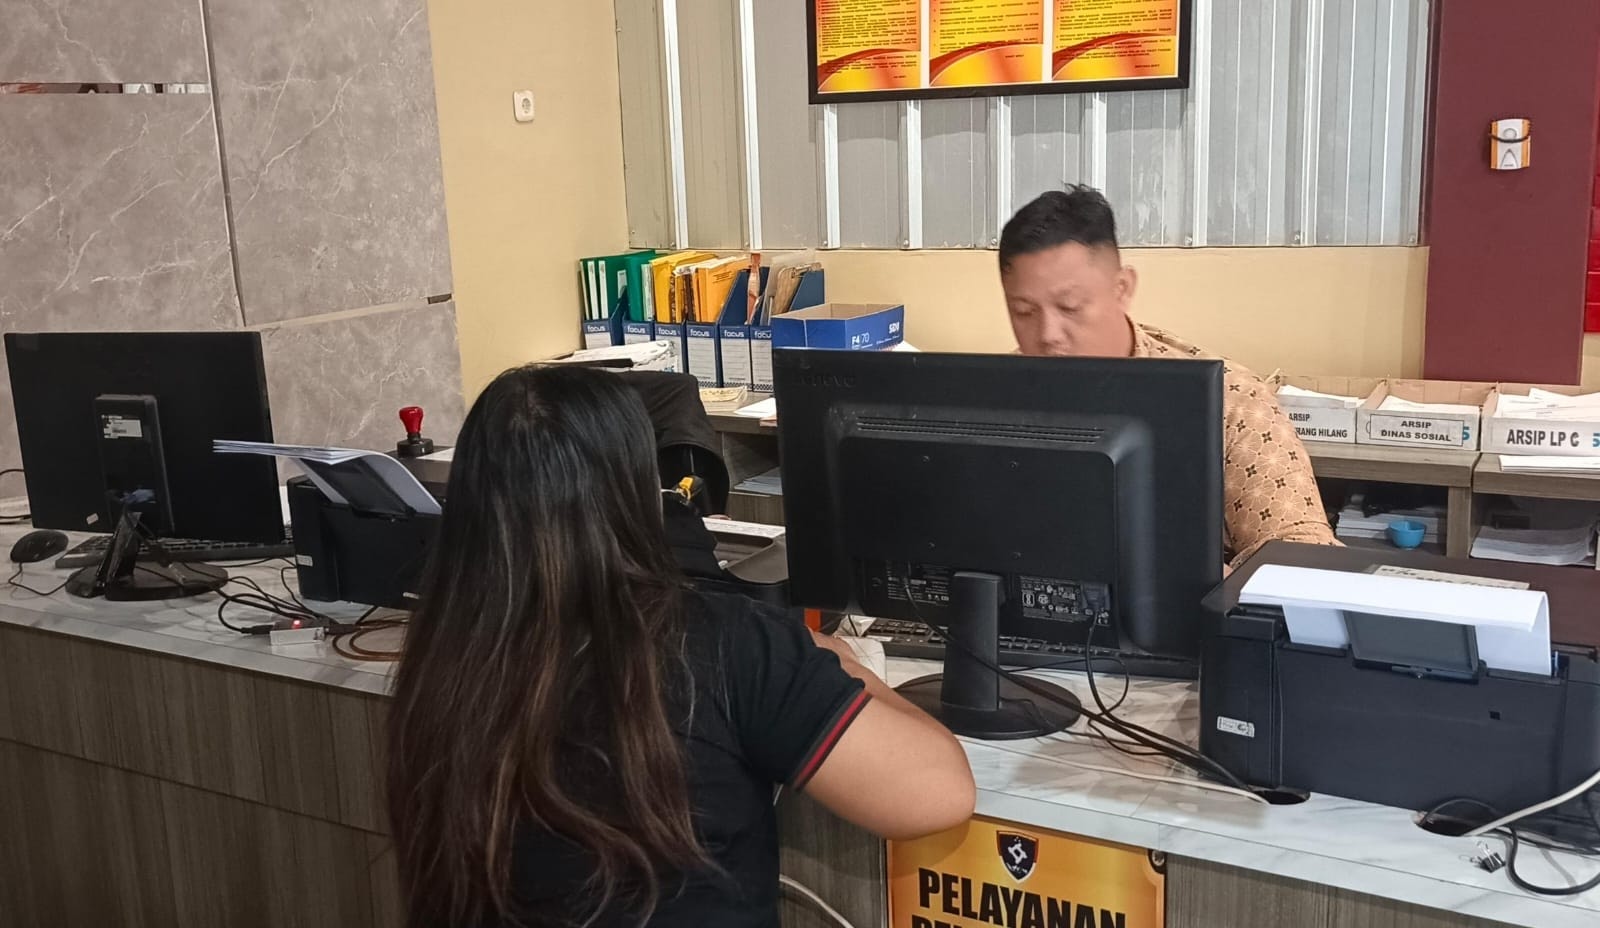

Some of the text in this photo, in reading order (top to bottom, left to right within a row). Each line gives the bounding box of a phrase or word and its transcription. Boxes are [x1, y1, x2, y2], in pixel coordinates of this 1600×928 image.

[627, 326, 646, 334] focus
[658, 327, 677, 335] focus
[690, 328, 710, 337] focus
[724, 329, 745, 338] focus
[754, 330, 772, 339] focu
[1288, 413, 1310, 421] ARSIP
[1401, 420, 1432, 429] ARSIP
[1295, 427, 1348, 438] RANG HILANG
[1381, 429, 1452, 442] DINAS SOSIAL
[1506, 429, 1580, 447] ARSIP LP C
